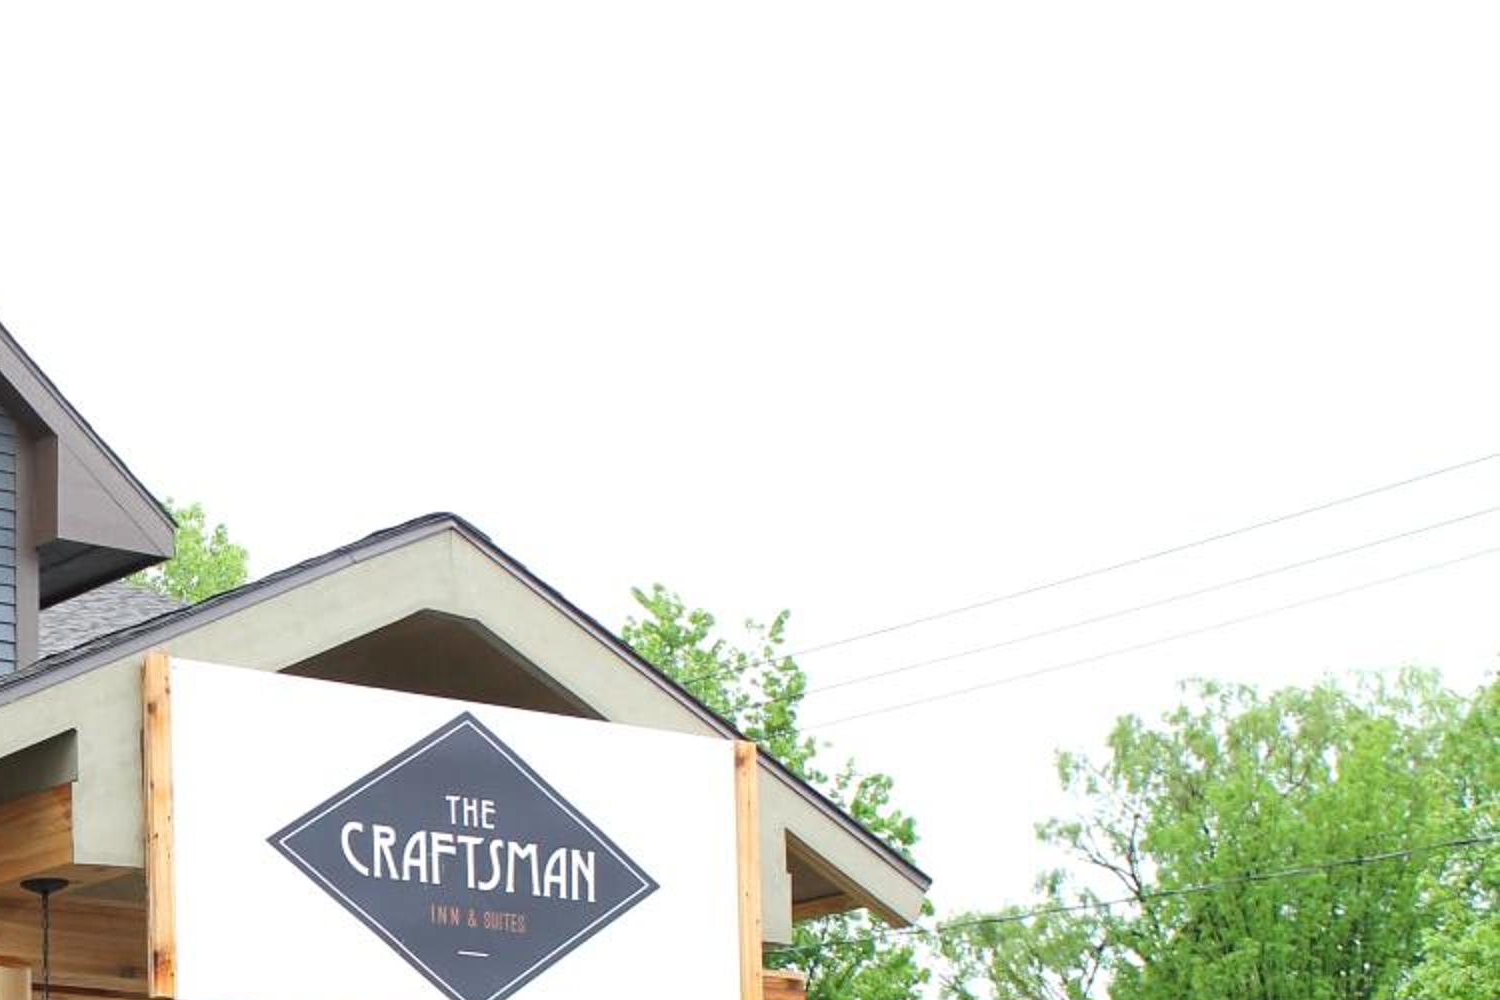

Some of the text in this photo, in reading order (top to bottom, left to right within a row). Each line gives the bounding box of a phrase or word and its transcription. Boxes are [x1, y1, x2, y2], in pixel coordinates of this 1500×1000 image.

[445, 795, 496, 829] THE
[341, 821, 596, 903] CRAFTSMAN
[431, 903, 525, 933] INN & SUITES
